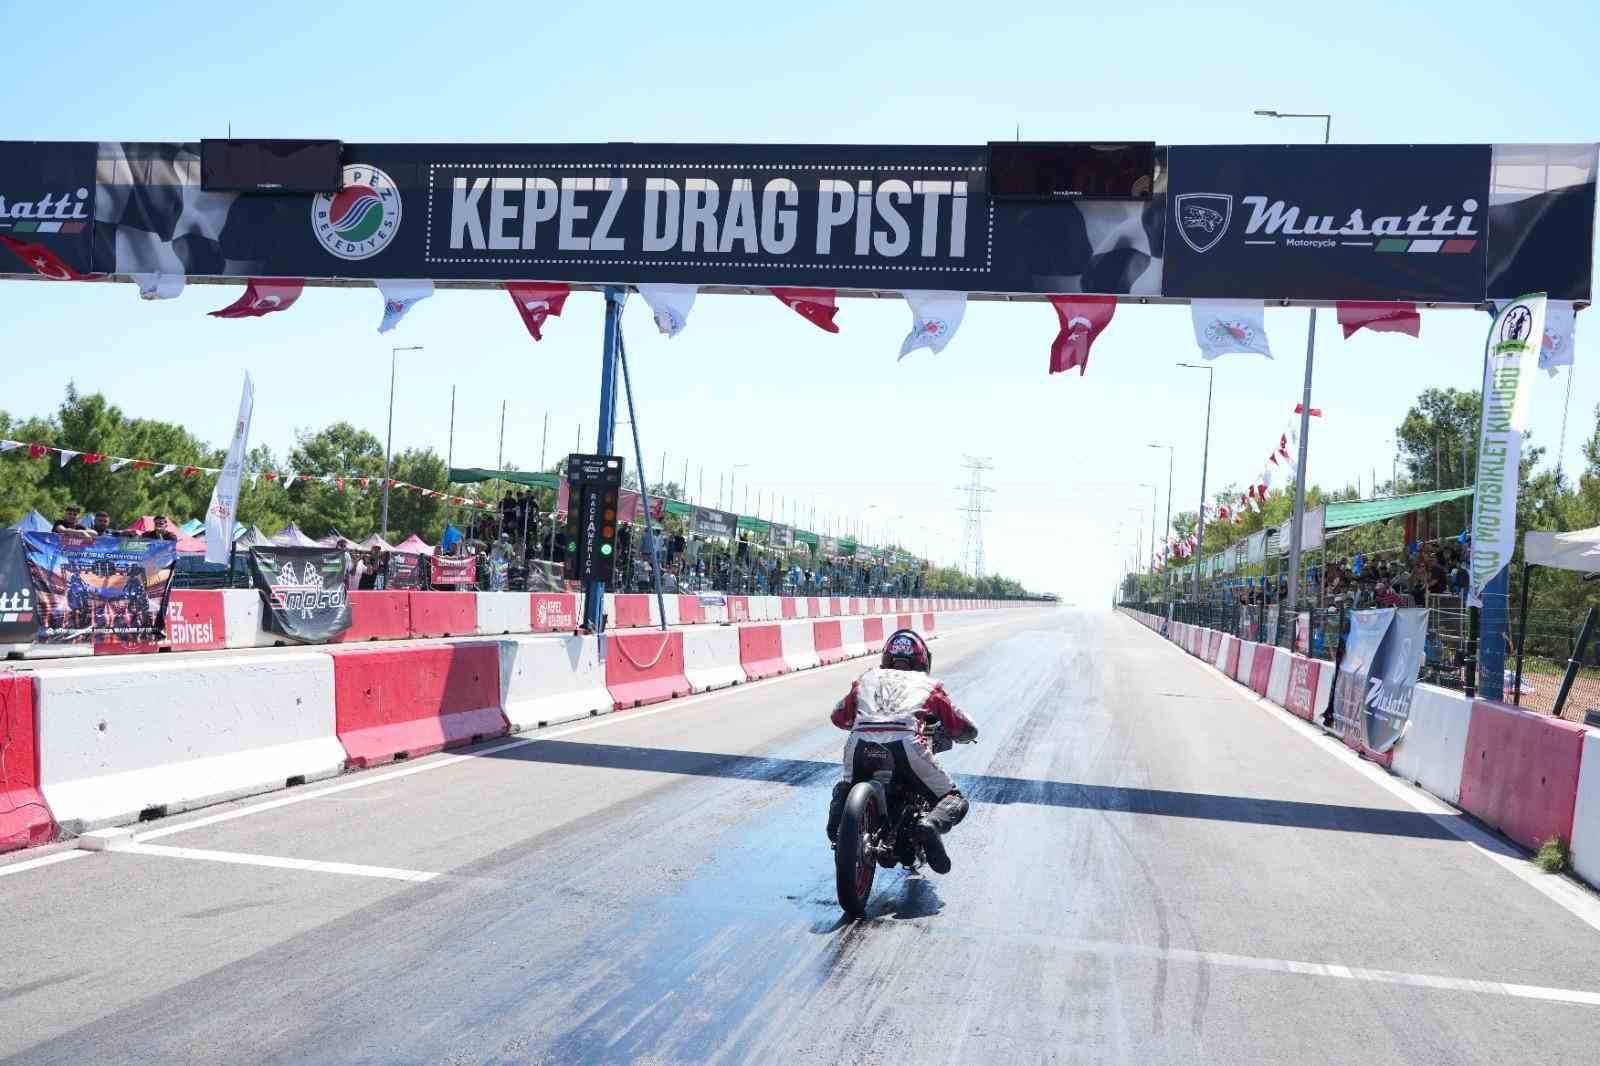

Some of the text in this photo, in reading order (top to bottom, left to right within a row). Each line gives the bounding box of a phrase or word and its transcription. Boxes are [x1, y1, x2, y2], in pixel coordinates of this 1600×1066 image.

[449, 177, 628, 251] KEPEZ
[642, 177, 799, 255] DRAG
[1241, 195, 1479, 236] Musatti
[1286, 237, 1337, 248] Motorcycle
